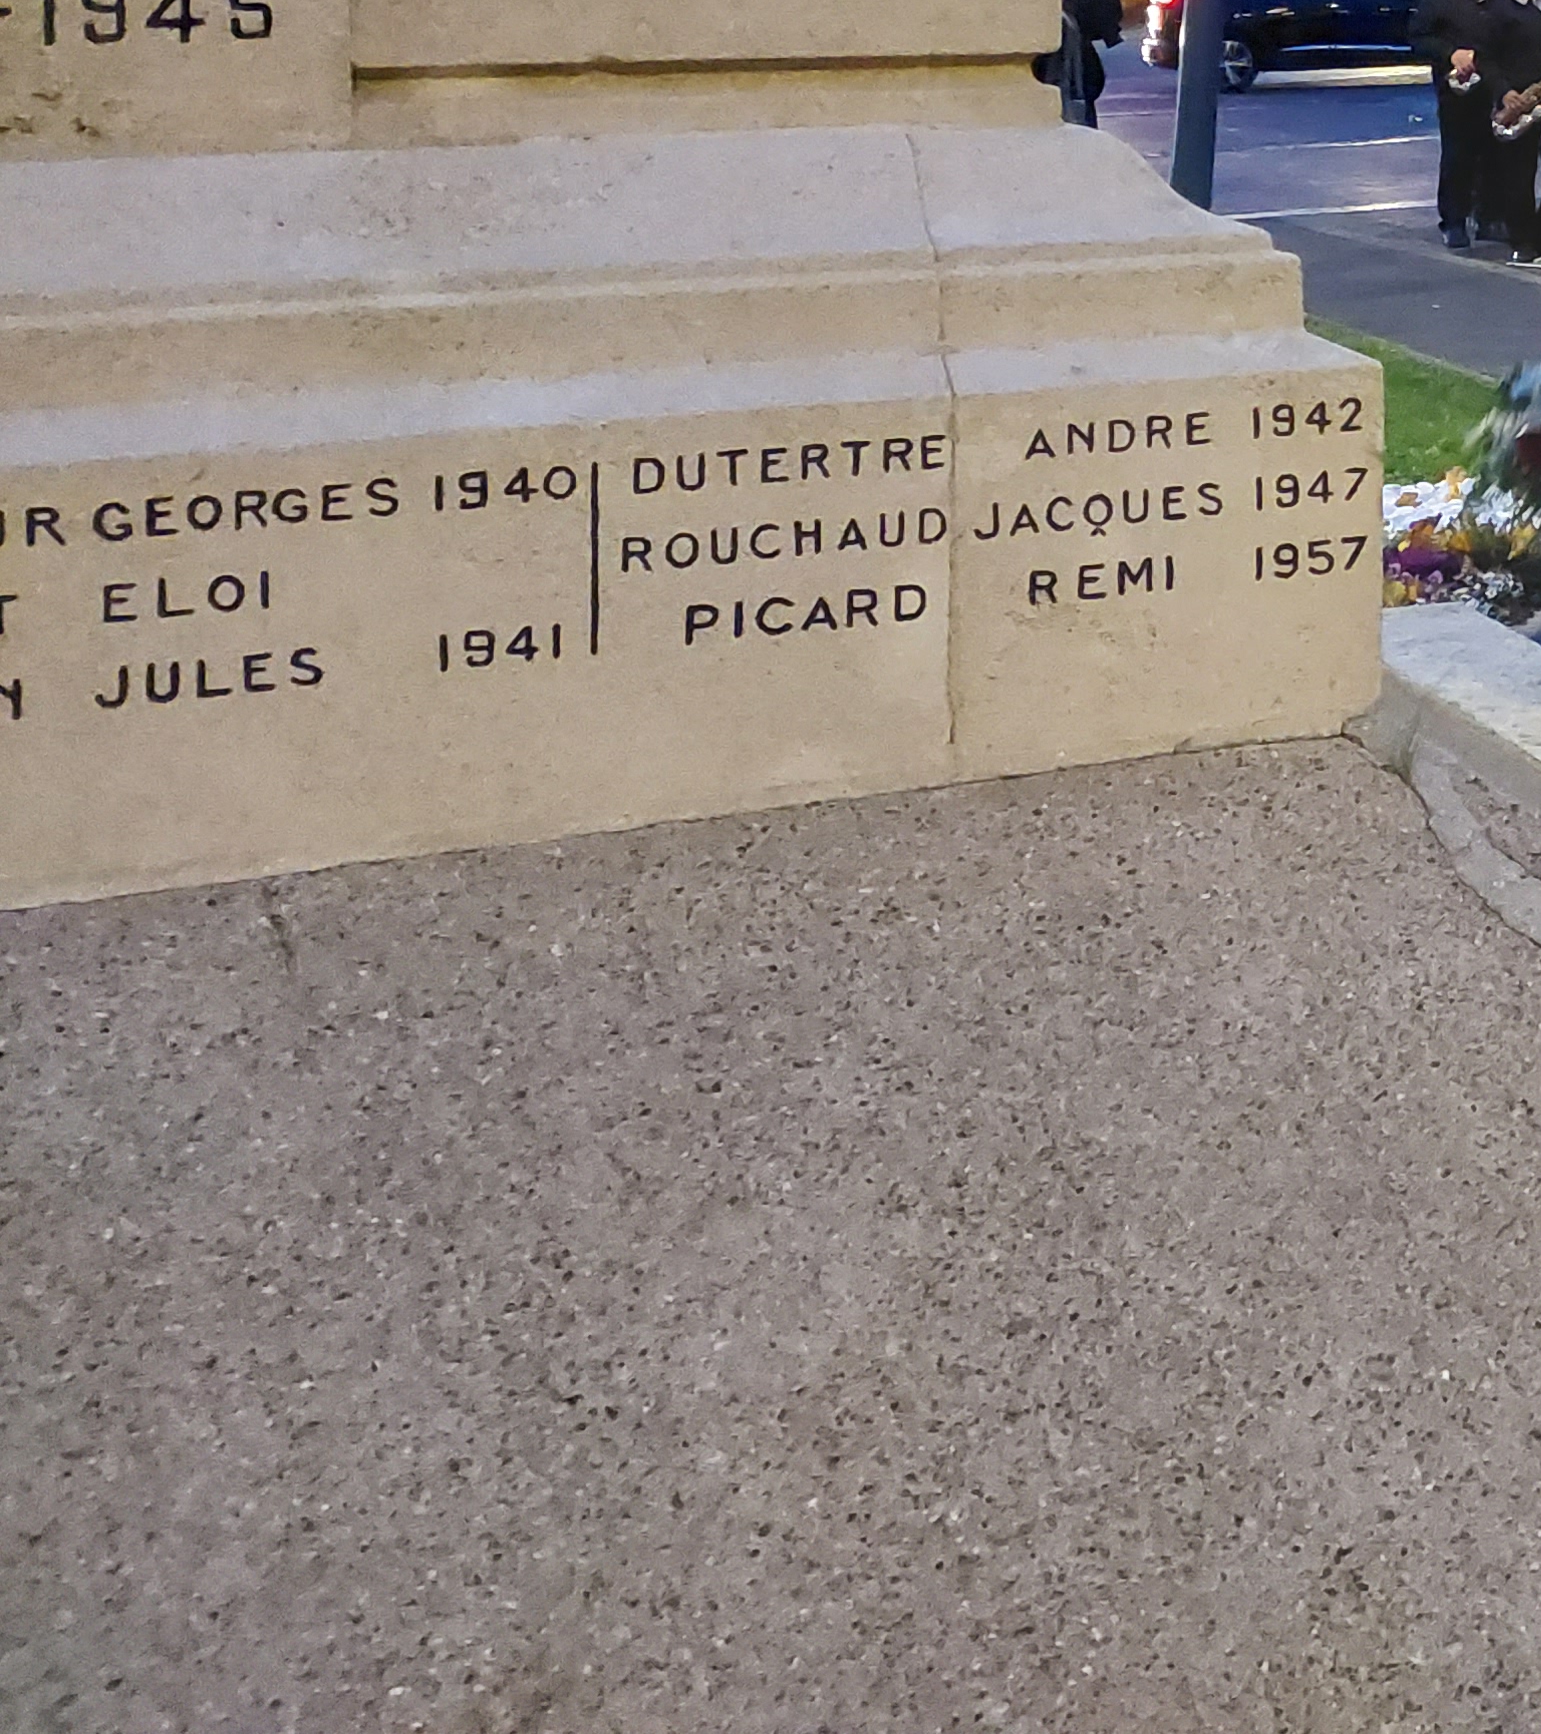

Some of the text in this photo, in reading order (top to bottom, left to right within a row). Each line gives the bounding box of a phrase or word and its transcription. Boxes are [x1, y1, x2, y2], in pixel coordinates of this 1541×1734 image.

[633, 397, 1362, 494] DUTERTRE ANDRE 1942
[0, 466, 576, 547] R GEORGES 1940
[621, 467, 1368, 572] ROUCHAUD JACQUES 1947
[103, 571, 269, 623] ELOI
[685, 536, 1368, 645] PICARD REMI 1957
[95, 647, 325, 709] JULES
[439, 623, 561, 672] 1941
